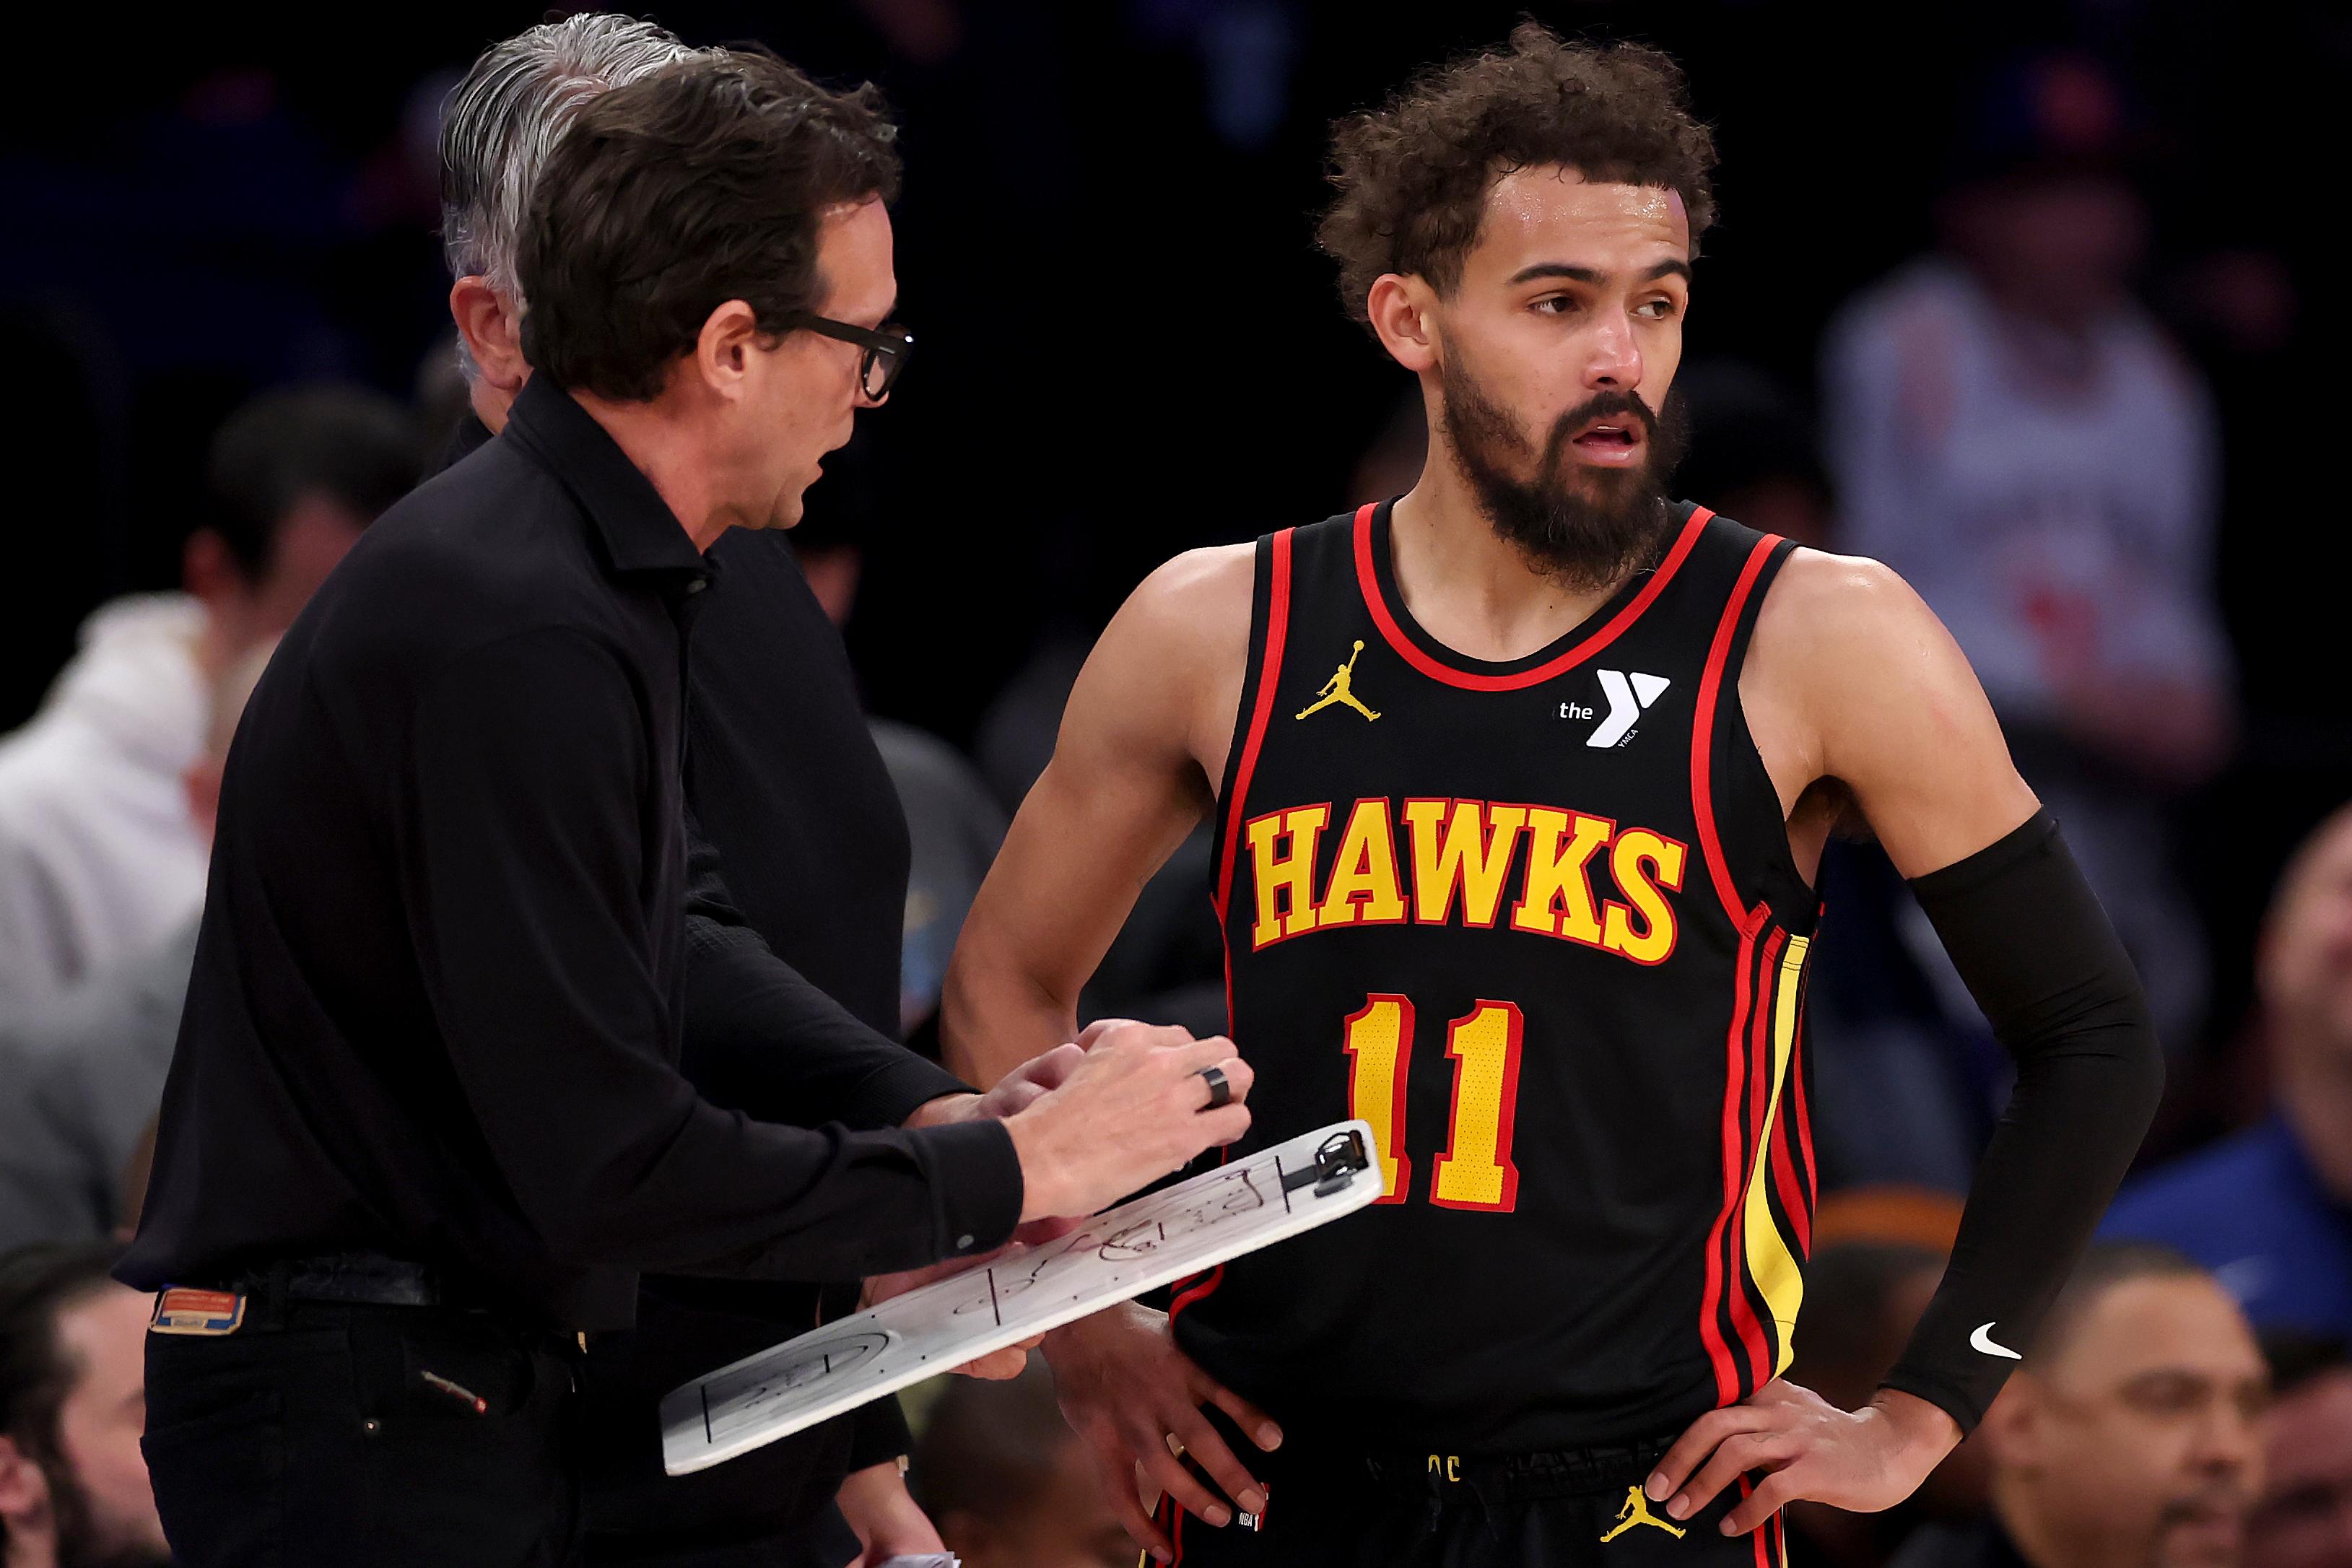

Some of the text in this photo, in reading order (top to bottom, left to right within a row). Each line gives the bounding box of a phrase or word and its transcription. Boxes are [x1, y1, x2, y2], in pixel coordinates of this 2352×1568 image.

[1559, 702, 1593, 720] the
[1617, 728, 1639, 749] YMCA
[1245, 796, 1689, 967] HAWKS
[1342, 993, 1524, 1213] 11
[1238, 1512, 1253, 1528] NBA
